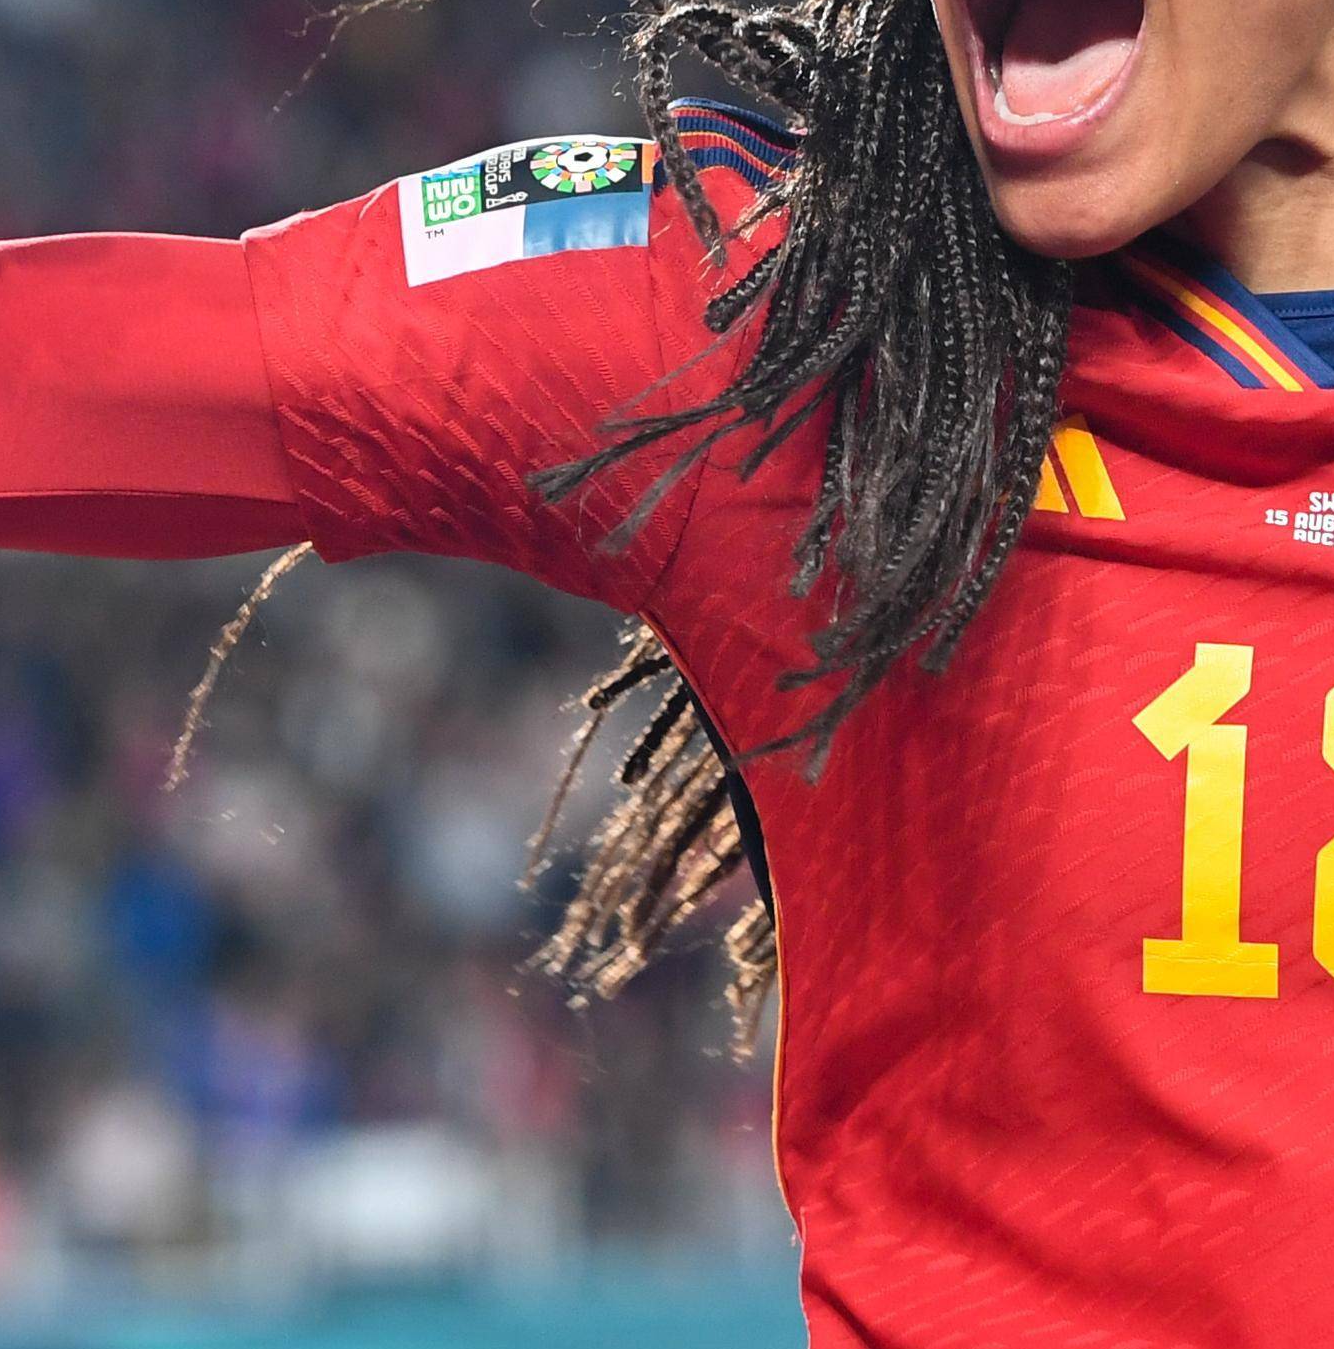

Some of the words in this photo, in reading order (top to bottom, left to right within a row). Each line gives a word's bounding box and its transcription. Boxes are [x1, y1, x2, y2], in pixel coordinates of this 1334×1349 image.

[427, 181, 450, 222] 23
[452, 176, 475, 215] 20
[426, 229, 444, 240] TM
[1265, 509, 1289, 526] 15
